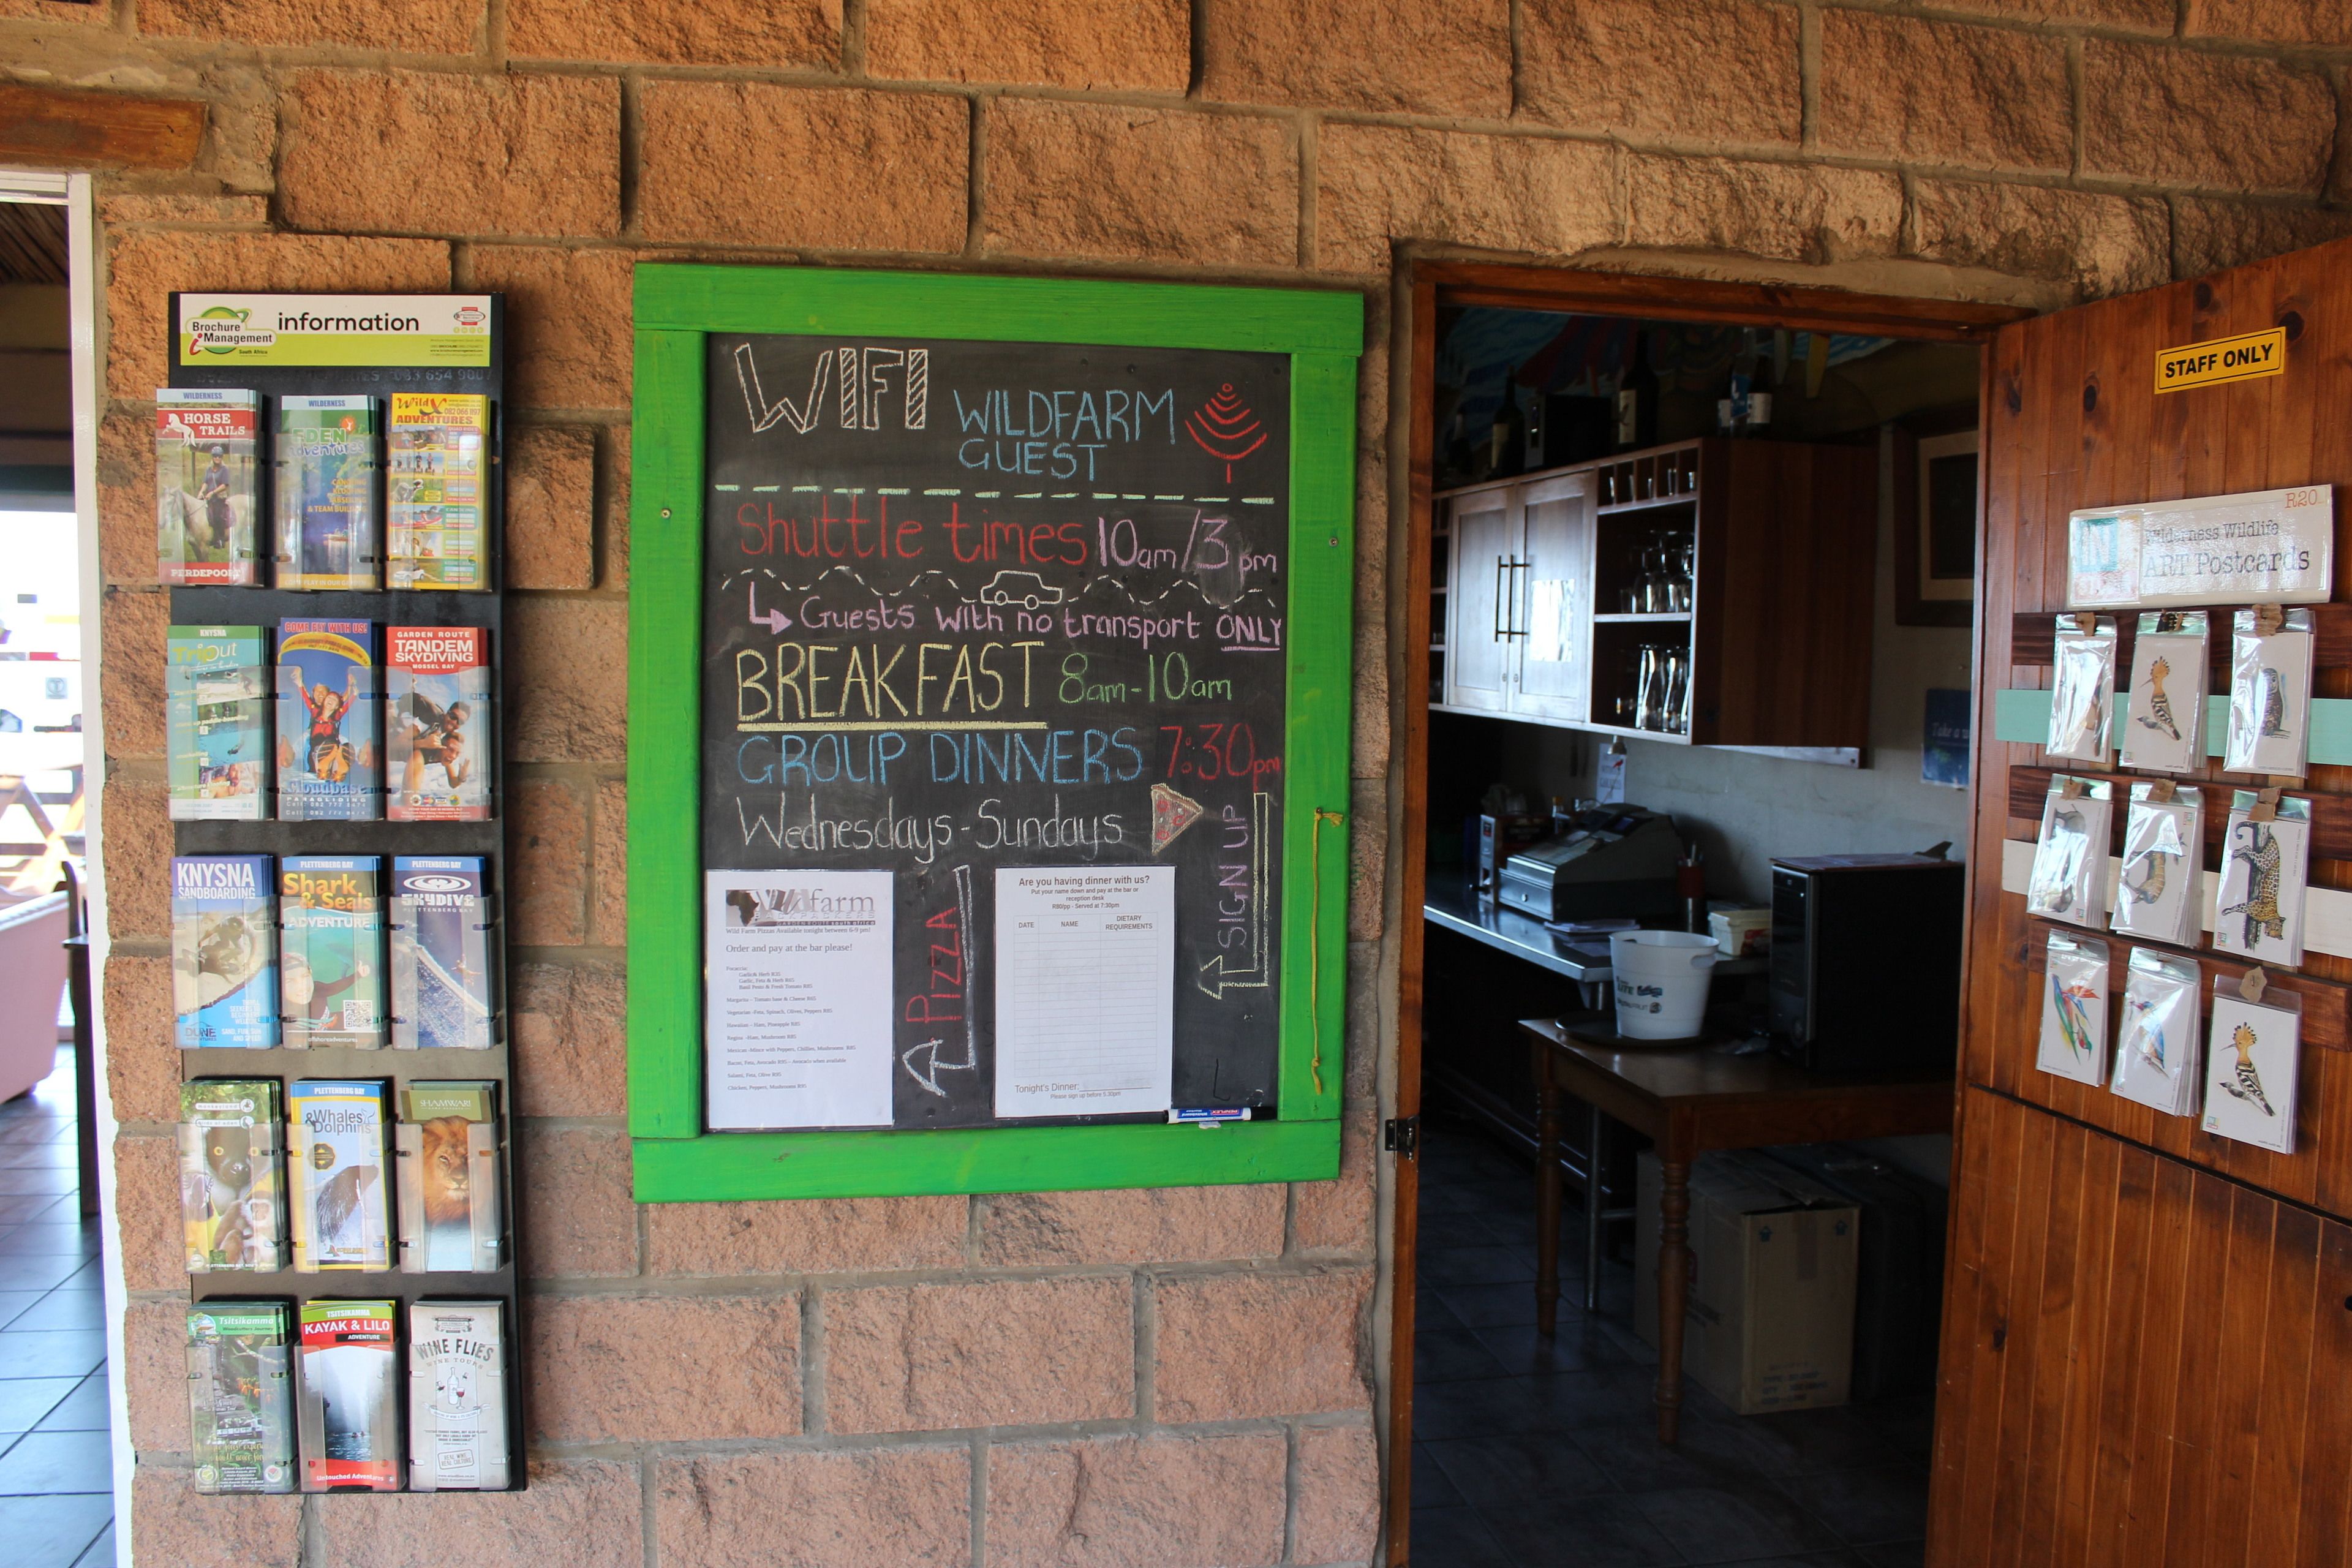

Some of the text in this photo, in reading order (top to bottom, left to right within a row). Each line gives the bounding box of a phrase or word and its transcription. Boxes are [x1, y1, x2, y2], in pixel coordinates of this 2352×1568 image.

[193, 322, 241, 332] Brochure
[279, 312, 419, 331] information
[204, 333, 273, 344] Management
[2165, 342, 2274, 379] STAFF ONLY
[734, 342, 929, 435] WIFI
[397, 398, 429, 409] Wild
[184, 413, 231, 424] HORSE
[396, 415, 473, 424] ADVENTURES
[953, 388, 1176, 444] WILDFARM
[200, 426, 245, 435] TRAILS
[292, 428, 347, 444] EDEN
[289, 441, 364, 456] adventures
[958, 439, 1107, 481] GUEST
[2285, 489, 2318, 509] R20
[737, 494, 924, 559] Shuttle
[942, 501, 1088, 565] times
[2223, 519, 2279, 538] Wildlife
[2144, 547, 2310, 578] ART Postcards
[285, 622, 368, 634] COME FLY WITH US!
[800, 597, 916, 633] Guests
[1017, 612, 1052, 633] no
[1064, 606, 1200, 650] transport
[1216, 614, 1281, 643] ONLY
[394, 640, 473, 652] TANDEM
[395, 652, 473, 663] SKYDIVING
[736, 641, 1046, 723] BREAKFAST
[738, 730, 907, 786] GROUP
[930, 726, 1144, 784] DINNERS
[736, 790, 1124, 864] Wednesdays Sundays
[177, 862, 255, 888] KNYSNA
[1019, 875, 1150, 889] Are you having dinner with us?
[1218, 804, 1248, 948] SIGN UP
[283, 872, 357, 895] Shark
[178, 887, 255, 899] SANDBOARDING
[401, 894, 475, 907] SKYDIVE
[300, 892, 373, 910] & Seals
[288, 916, 371, 928] ADVENTURE
[726, 944, 749, 952] Order
[768, 946, 783, 954] pay
[824, 943, 853, 954] please!
[905, 906, 962, 1023] PIZZA
[1014, 1082, 1079, 1093] Tonight's Dinner:
[306, 1109, 363, 1127] & Whales
[314, 1121, 372, 1136] Dolphins
[219, 1316, 274, 1325] Tsitsikamma
[326, 1309, 371, 1318] TSITSIKAMMA
[304, 1320, 390, 1335] KAYAK & LILO
[416, 1338, 494, 1362] WINE FLIES
[426, 1358, 484, 1370] WINE TOURS
[352, 1473, 384, 1482] Adventures
